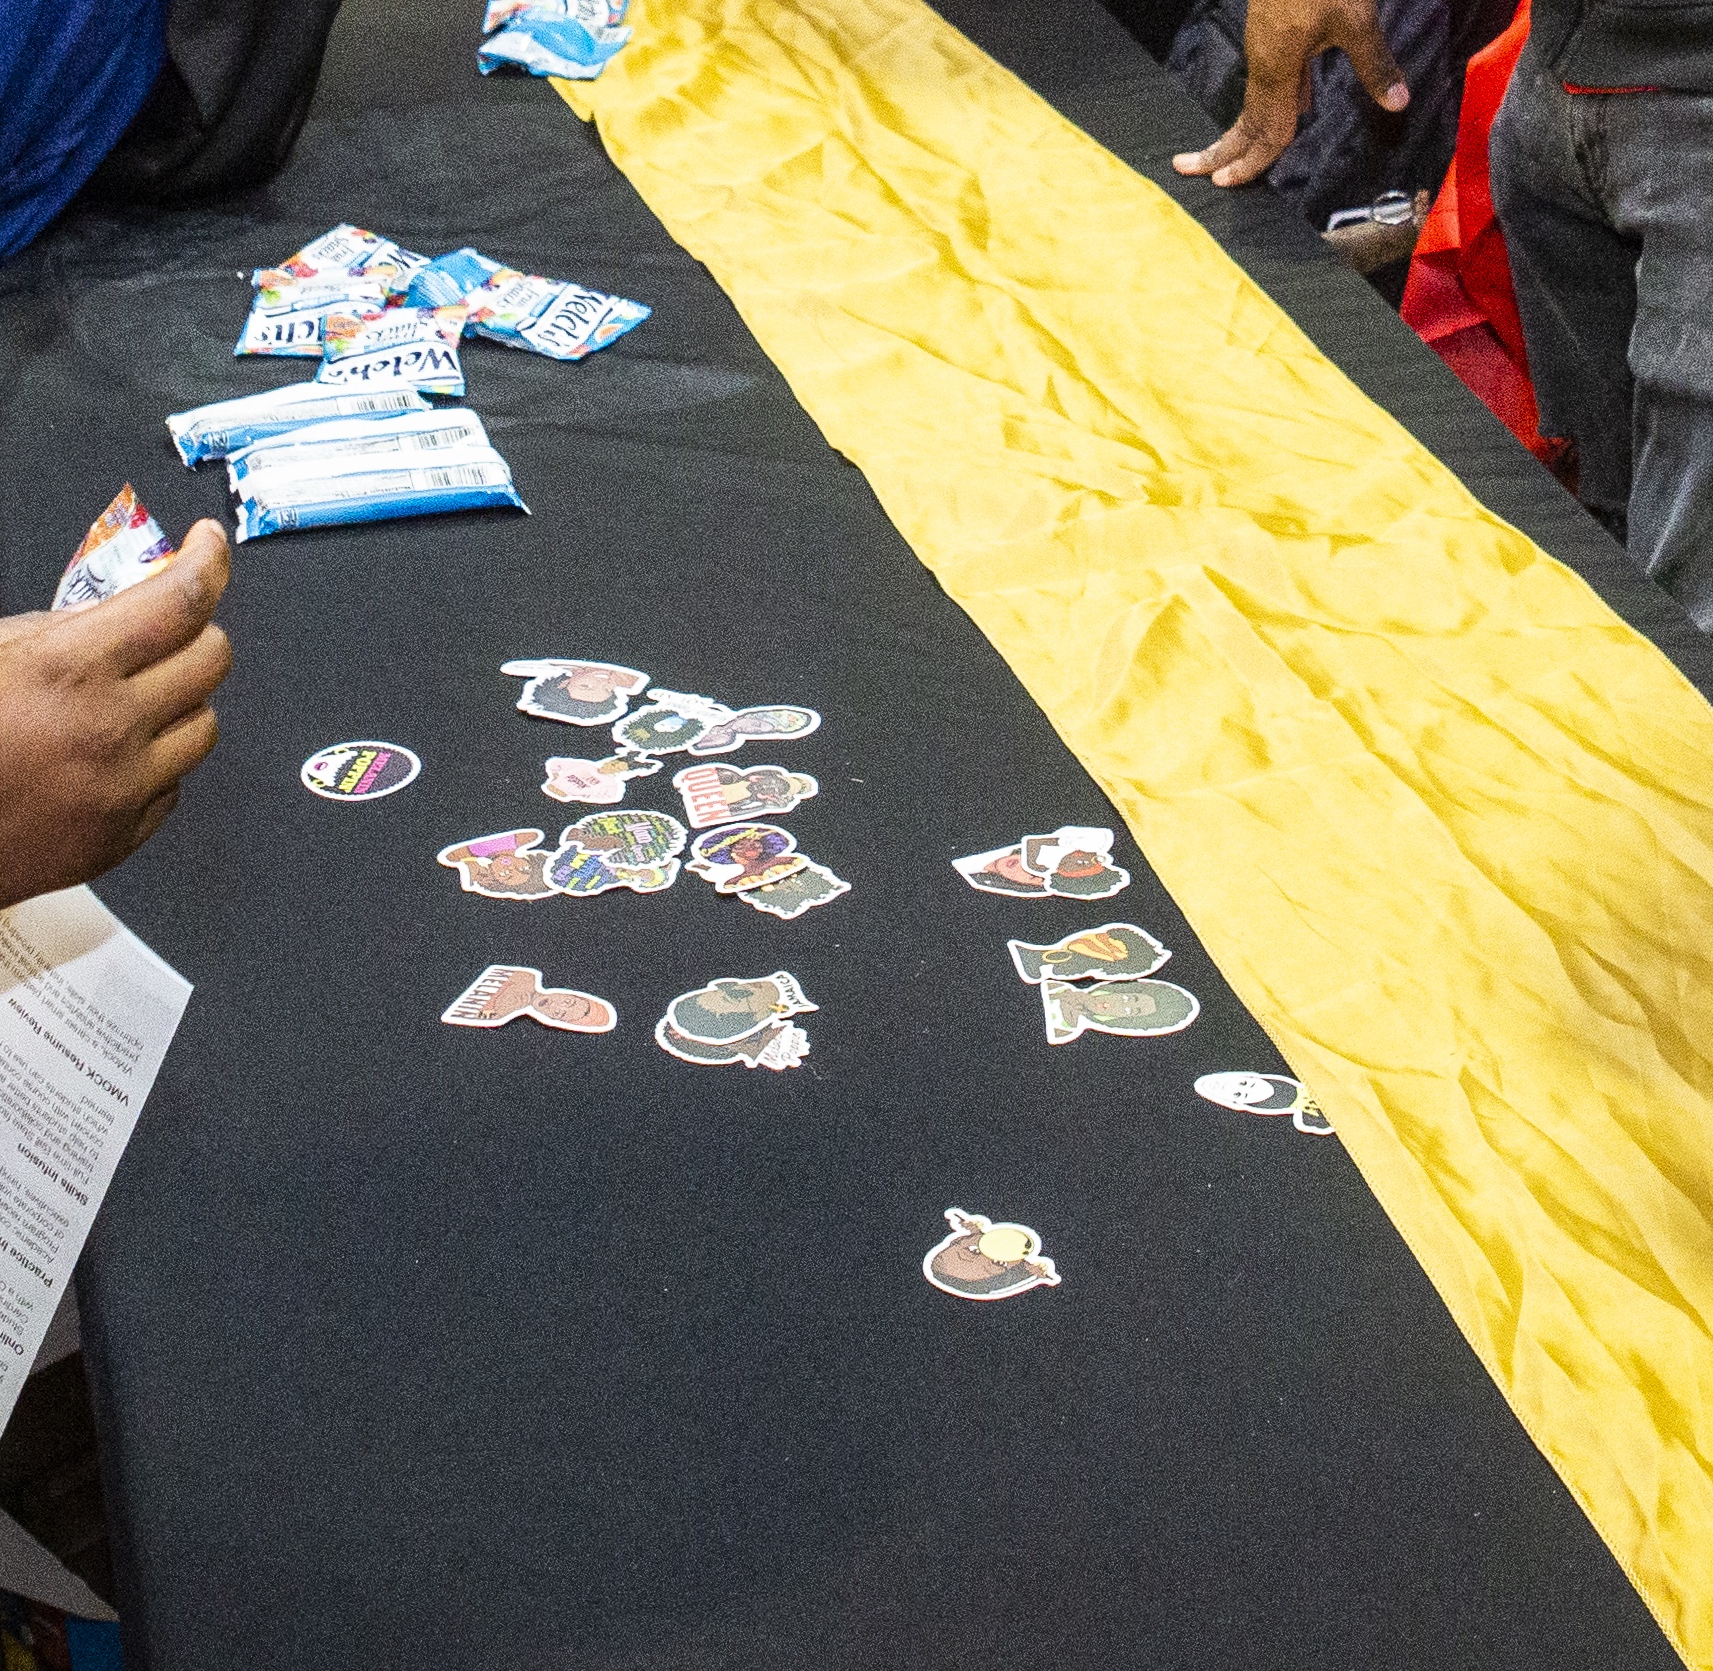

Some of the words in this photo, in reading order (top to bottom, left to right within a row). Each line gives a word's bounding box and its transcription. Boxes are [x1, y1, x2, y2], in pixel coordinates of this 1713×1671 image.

[253, 316, 323, 346] lch's
[328, 348, 461, 382] Welch's
[682, 767, 733, 825] QUEEN
[43, 980, 60, 1000] and
[451, 968, 514, 1019] MELANIN
[7, 996, 42, 1036] Review
[41, 996, 64, 1020] smart
[85, 1002, 105, 1023] their
[64, 1016, 91, 1043] career
[2, 1044, 12, 1058] to
[42, 1030, 84, 1072] Resume
[95, 1026, 139, 1064] predictive
[12, 1052, 28, 1070] use
[28, 1066, 45, 1084] can
[85, 1066, 130, 1106] VMOCK
[6, 1080, 30, 1106] better
[21, 1077, 51, 1106] course
[44, 1080, 82, 1116] students
[31, 1101, 67, 1136] students
[50, 1101, 69, 1123] with
[81, 1110, 108, 1137] which
[10, 1117, 34, 1142] State
[43, 1127, 61, 1147] and
[68, 1130, 88, 1152] help
[33, 1135, 51, 1156] Ball
[88, 1147, 99, 1161] to
[16, 1141, 58, 1183] Infusion
[58, 1176, 88, 1206] Skills
[12, 1194, 54, 1232] corporate
[21, 1217, 59, 1254] Program
[8, 1246, 53, 1288] Practice
[7, 1286, 14, 1296] a
[13, 1293, 33, 1312] with
